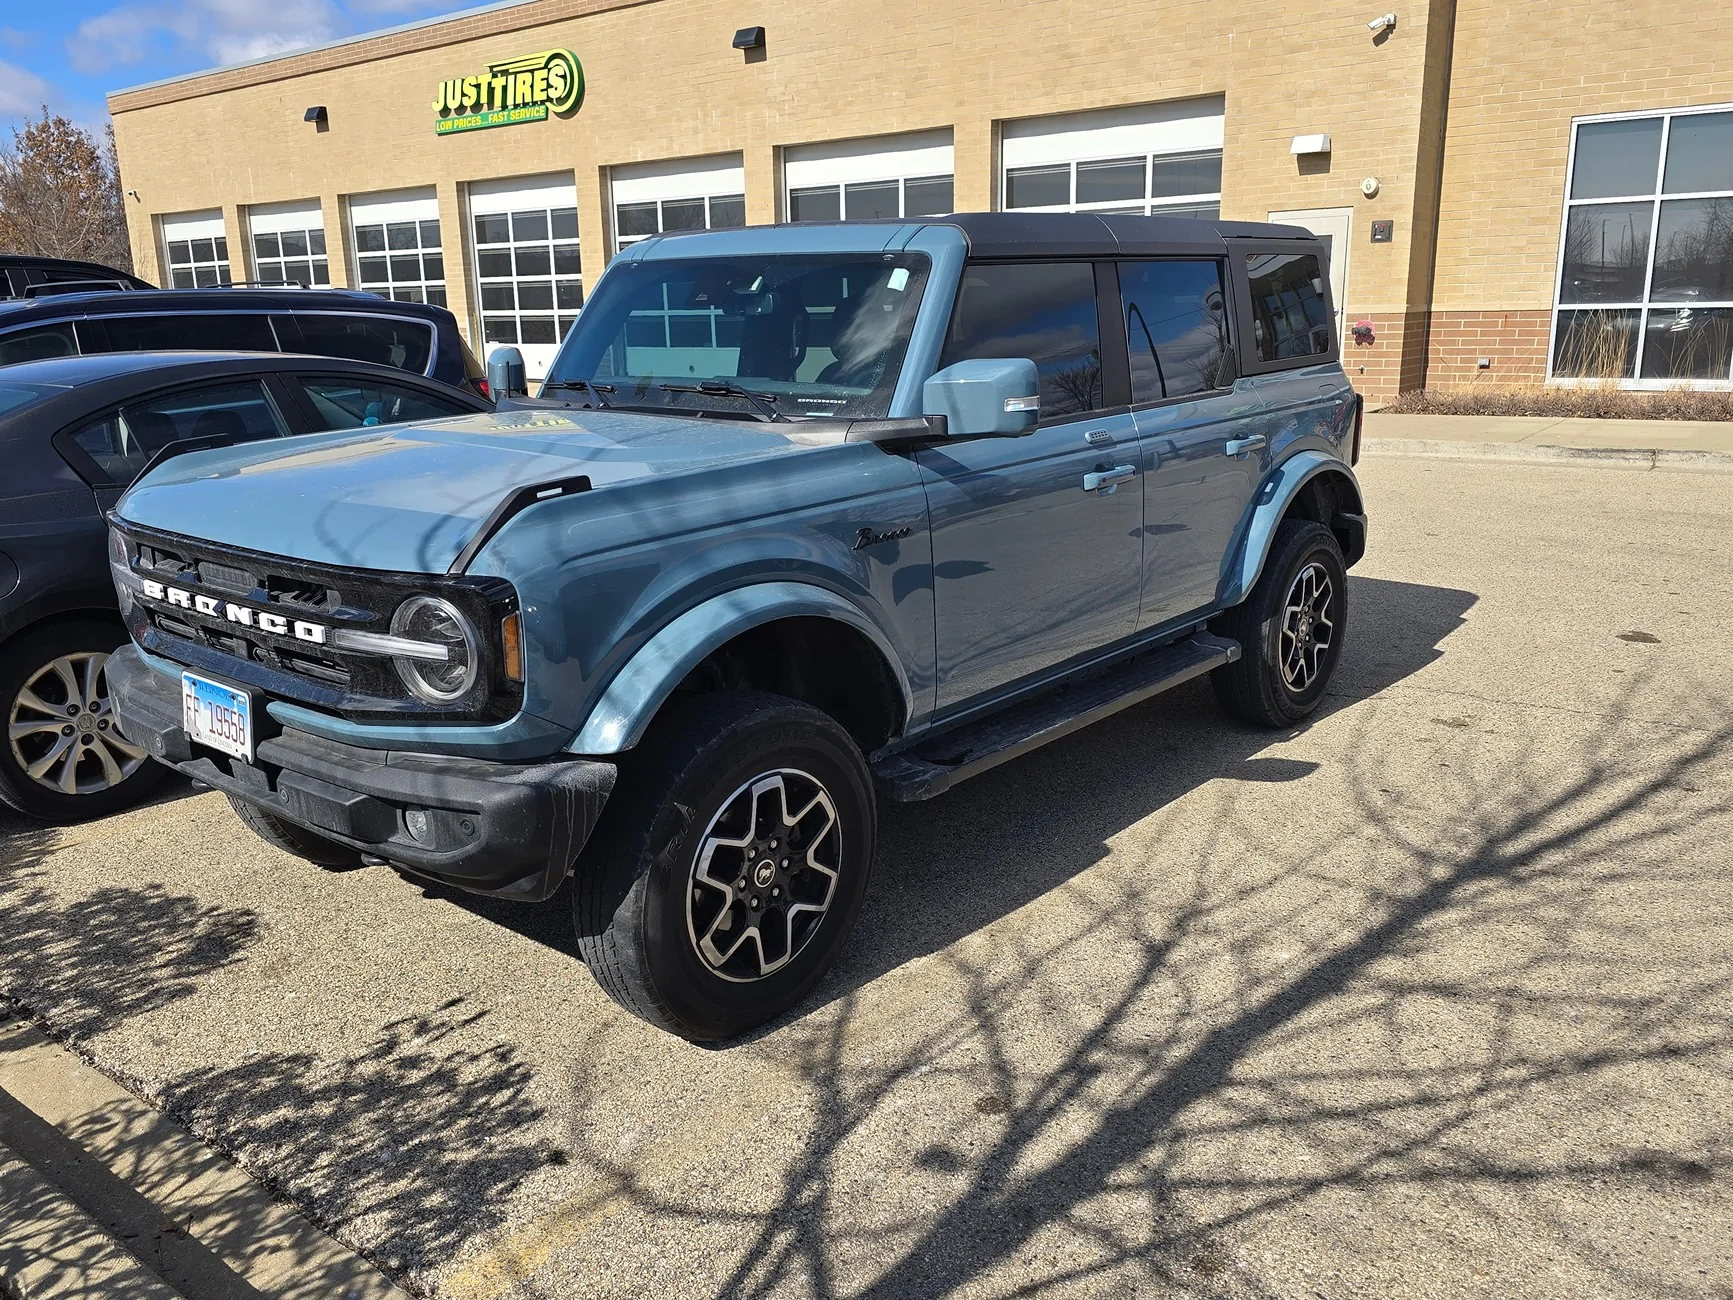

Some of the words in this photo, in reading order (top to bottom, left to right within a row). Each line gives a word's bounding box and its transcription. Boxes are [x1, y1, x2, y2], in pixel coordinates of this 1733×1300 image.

[436, 121, 453, 132] LOW
[489, 111, 508, 124] FAST
[510, 107, 545, 121] SERVICE
[850, 526, 913, 551] Bronco
[143, 579, 326, 644] BRONCO
[185, 693, 200, 728] FF
[208, 701, 246, 746] 19558
